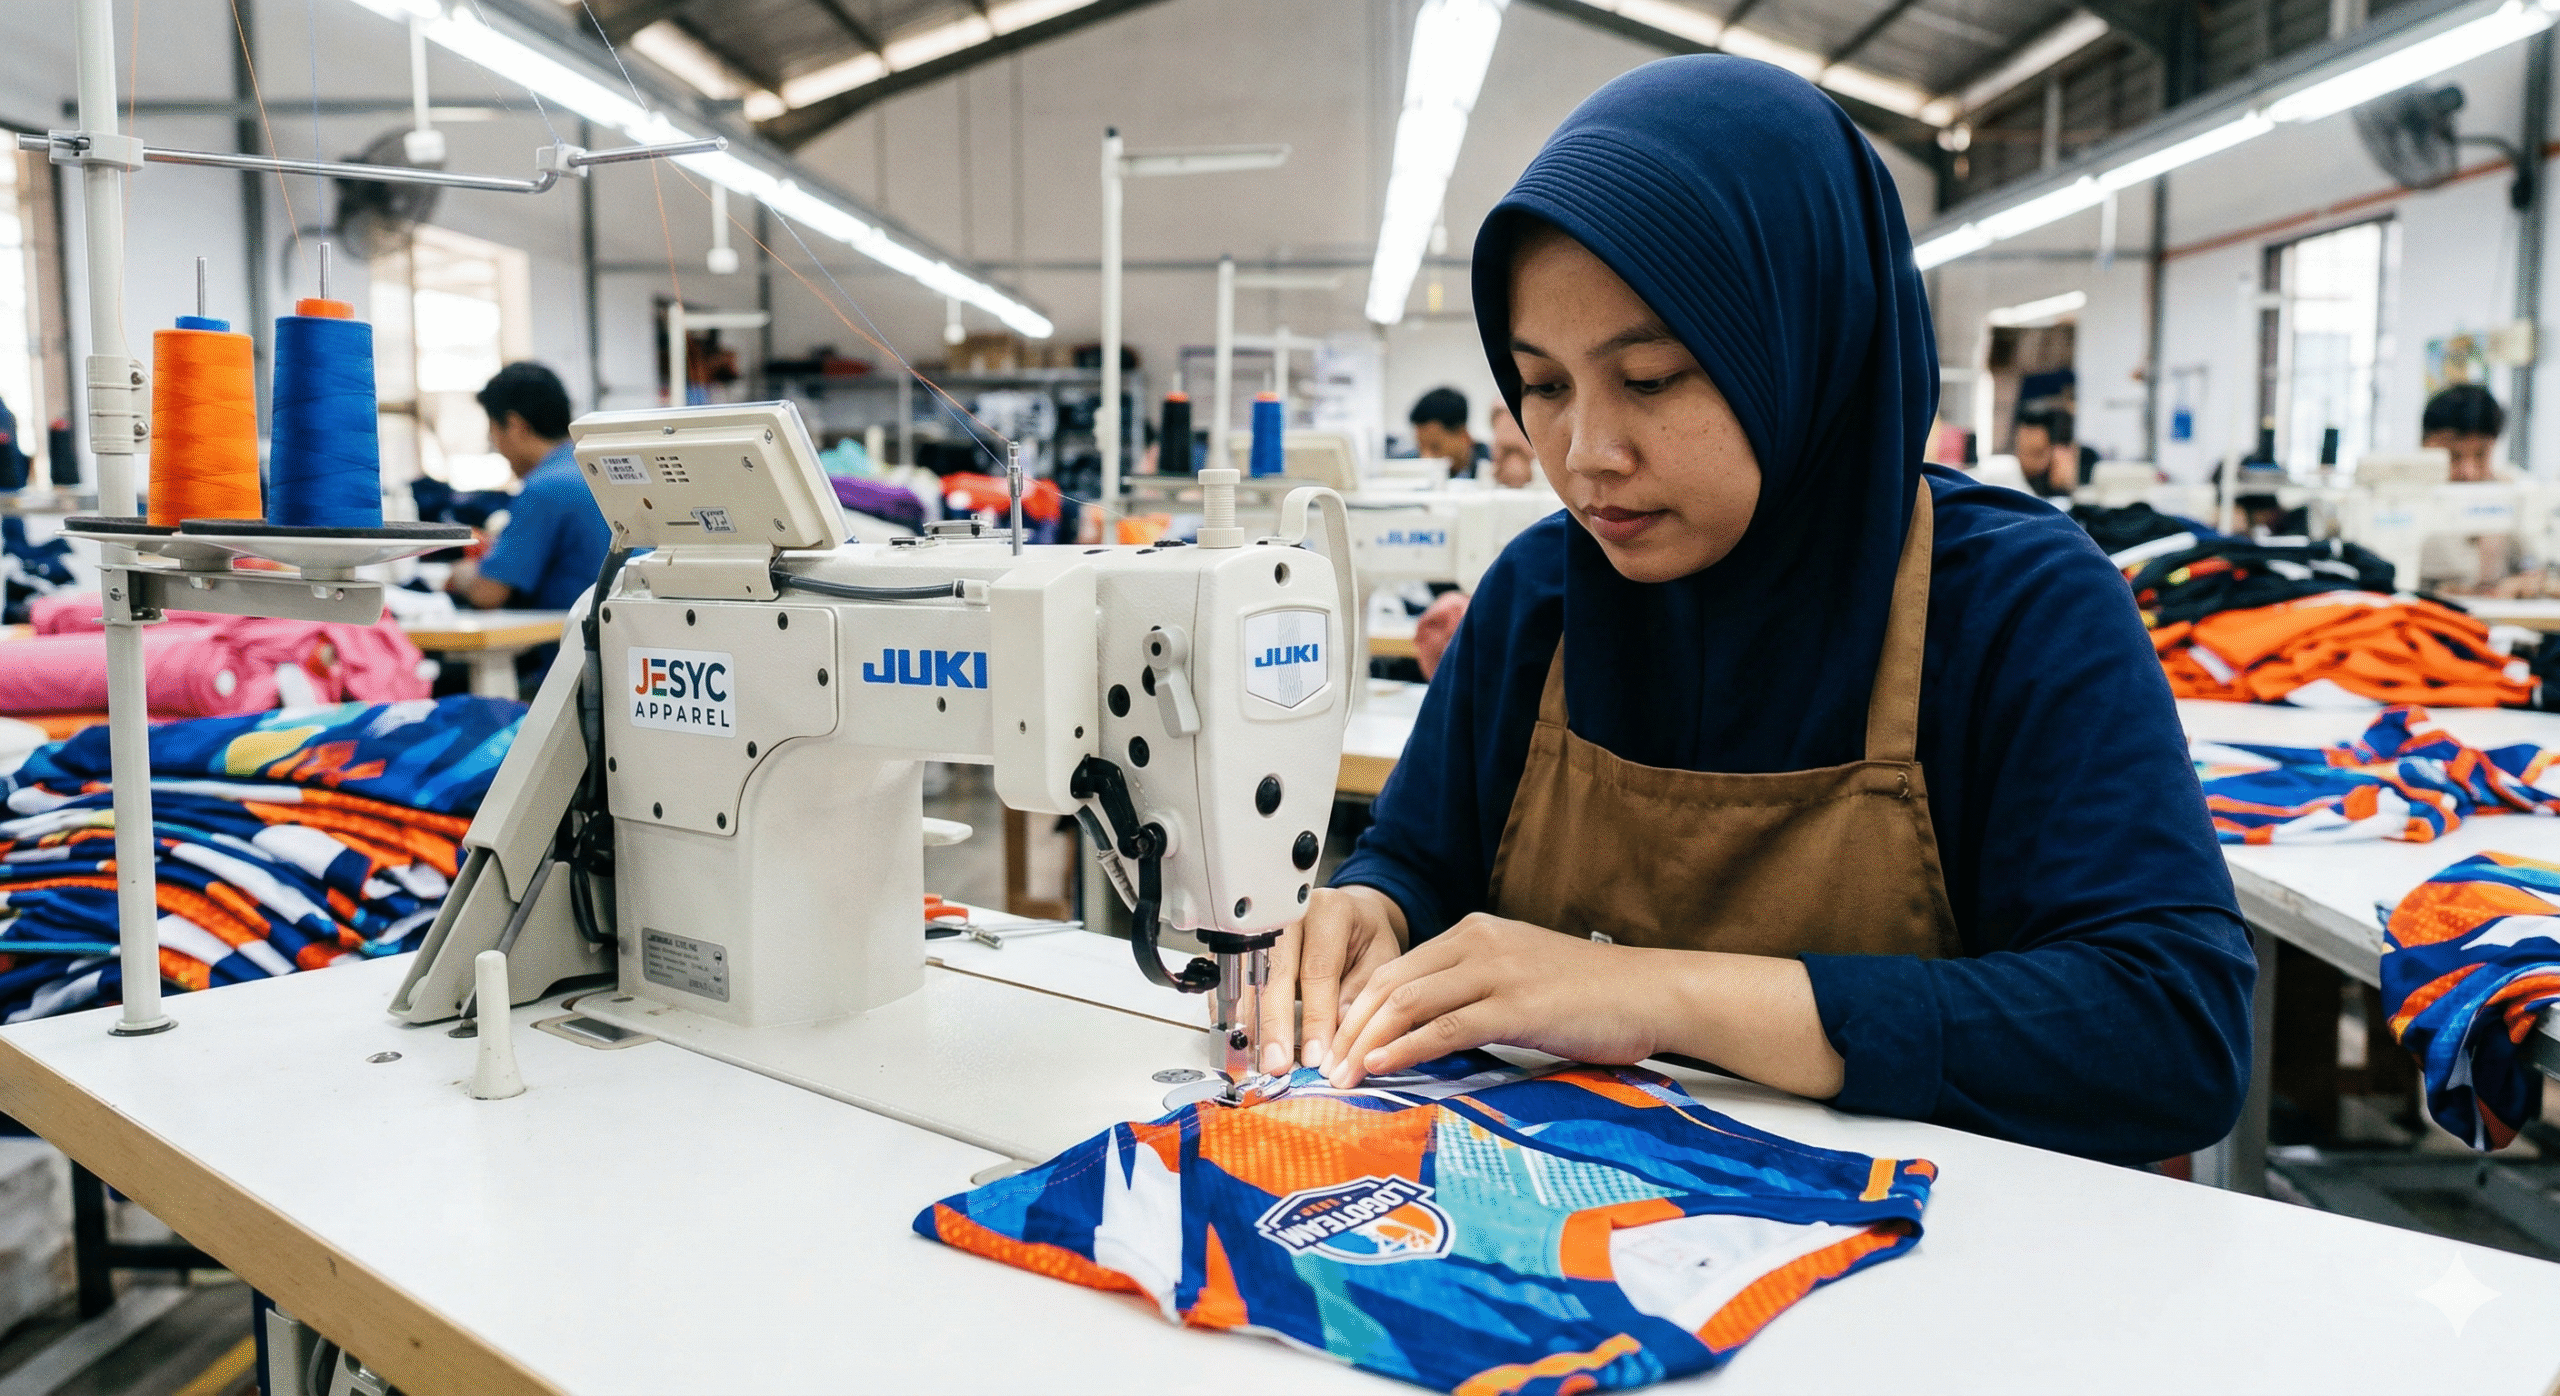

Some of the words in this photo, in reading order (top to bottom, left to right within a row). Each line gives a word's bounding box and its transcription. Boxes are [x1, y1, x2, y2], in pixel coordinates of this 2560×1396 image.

[863, 648, 988, 689] JUKI
[1254, 643, 1319, 668] JUKI
[635, 657, 728, 702] JESYC
[635, 701, 730, 728] APPAREL
[1276, 1181, 1418, 1247] LOGOTEAM
